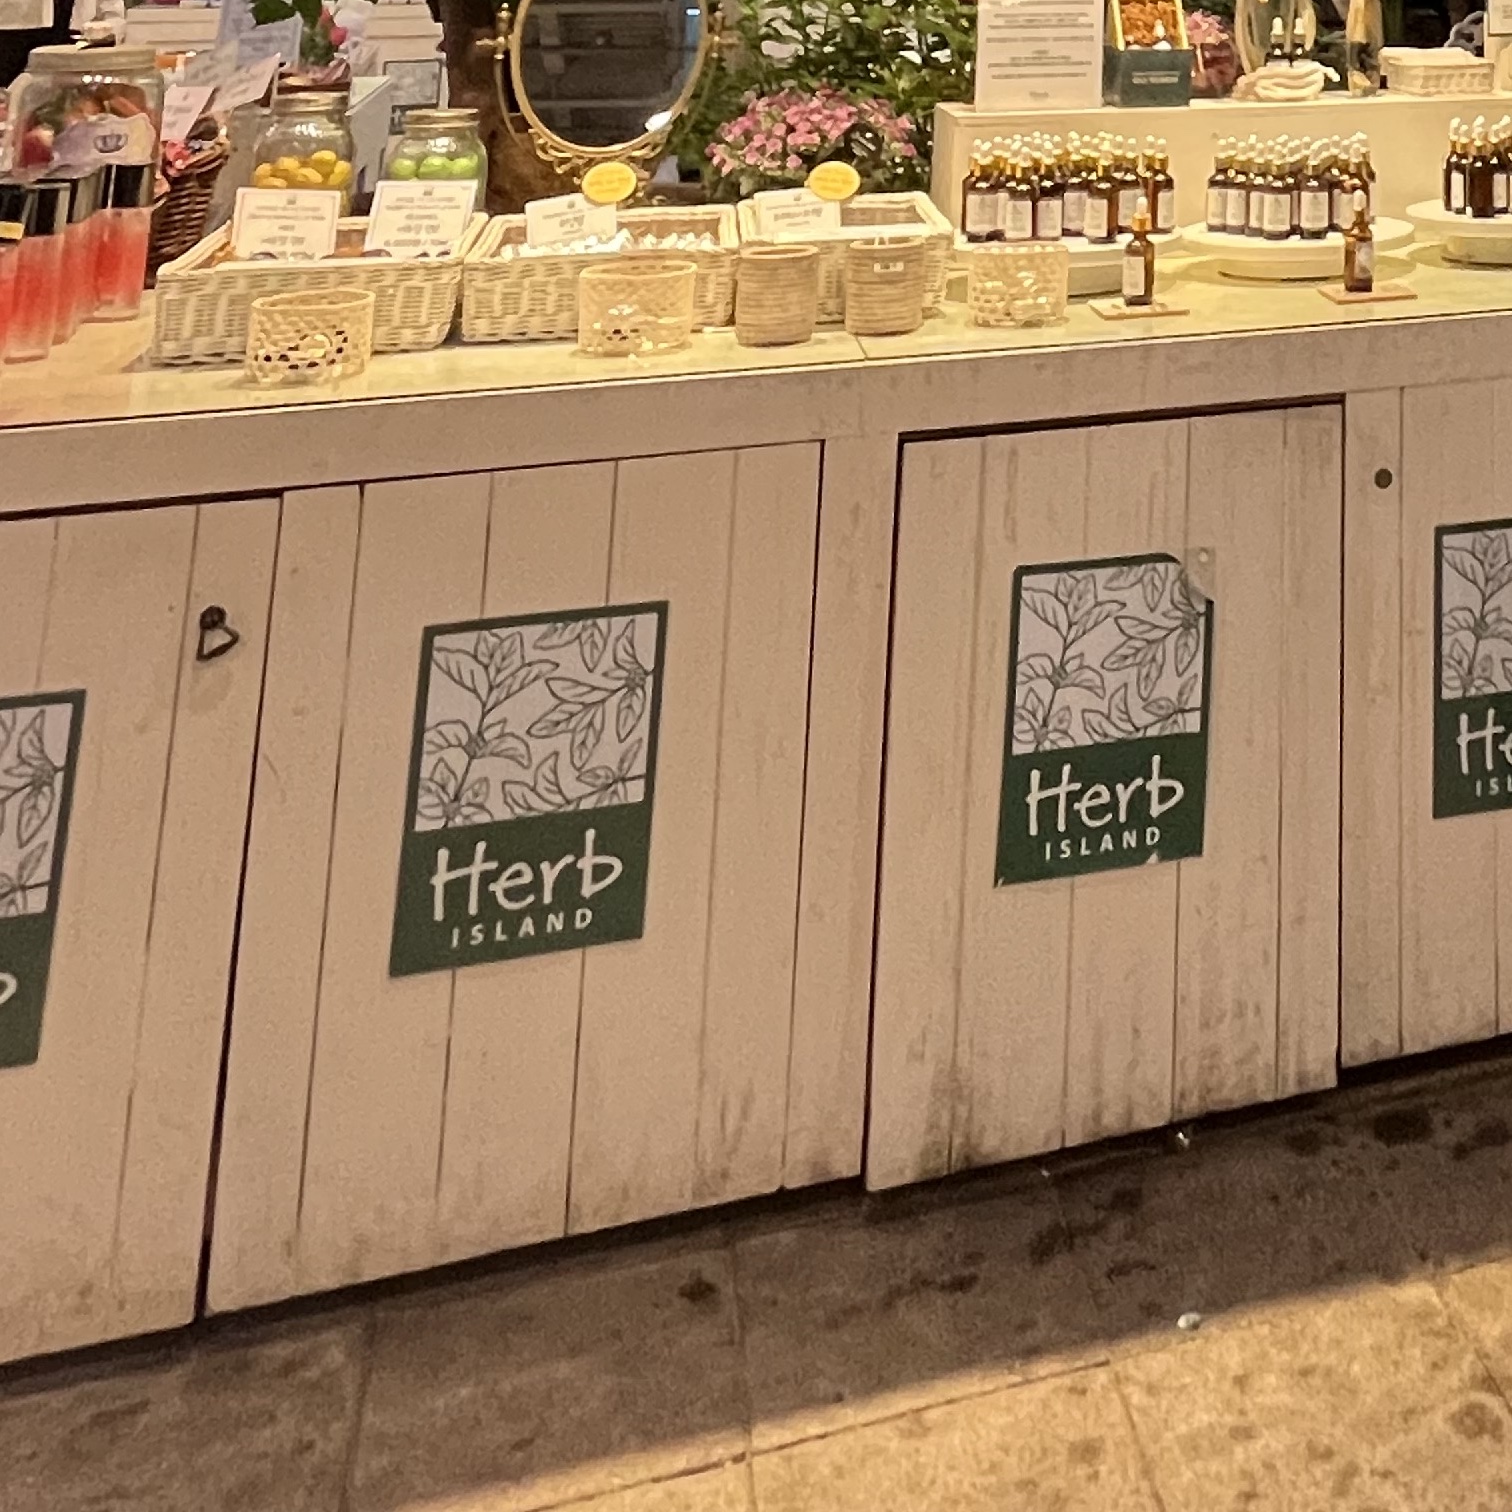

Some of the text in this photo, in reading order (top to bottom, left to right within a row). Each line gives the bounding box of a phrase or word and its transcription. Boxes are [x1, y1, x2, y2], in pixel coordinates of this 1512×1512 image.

[1025, 754, 1184, 836] Herb
[1045, 826, 1161, 862] ISLAND
[430, 828, 623, 922] Herb
[450, 907, 593, 948] ISLAND
